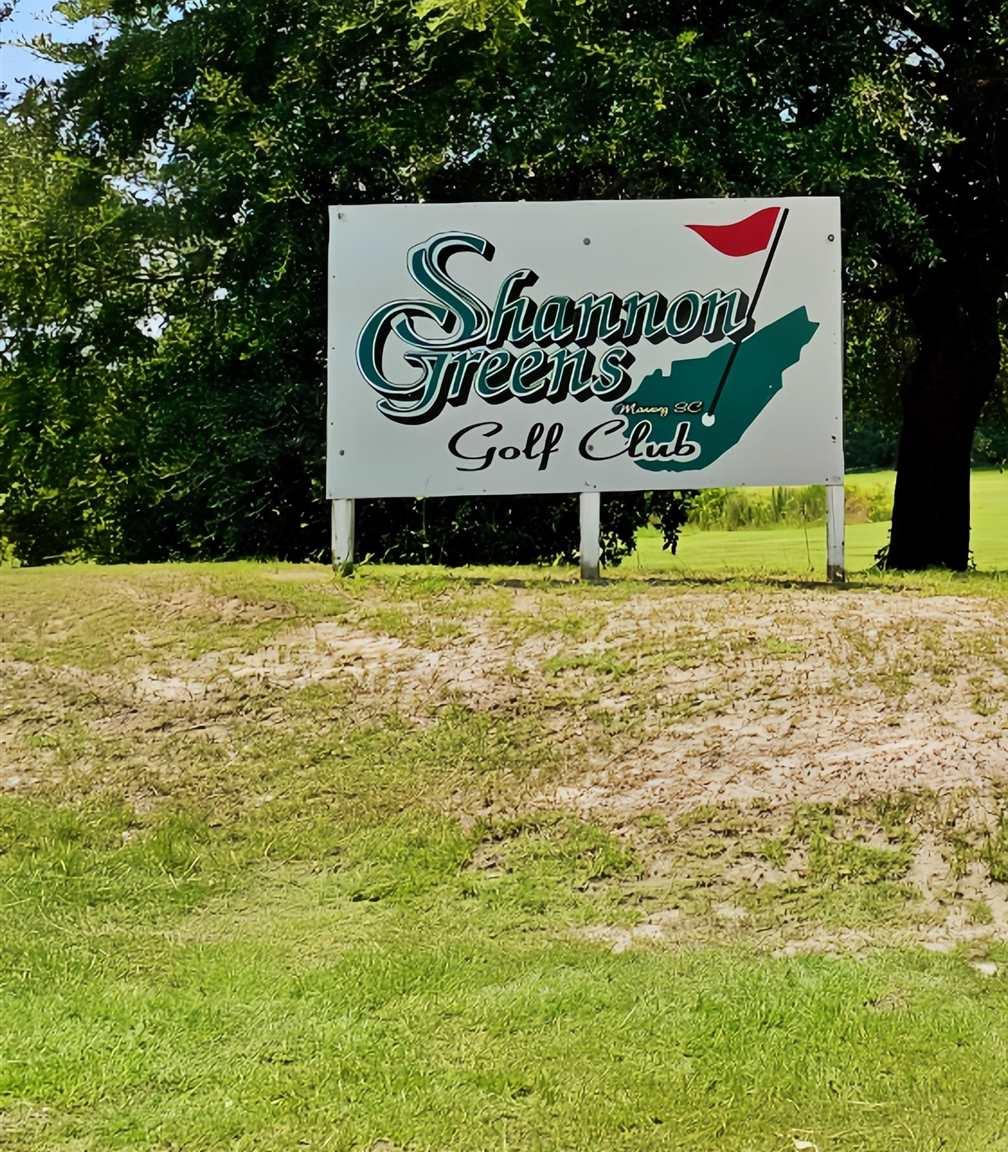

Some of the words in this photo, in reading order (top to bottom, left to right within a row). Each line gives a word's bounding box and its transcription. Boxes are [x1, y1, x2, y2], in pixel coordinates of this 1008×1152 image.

[407, 230, 756, 349] Shannon
[356, 298, 634, 426] Greens
[448, 421, 563, 472] Golf
[578, 419, 700, 461] Club
